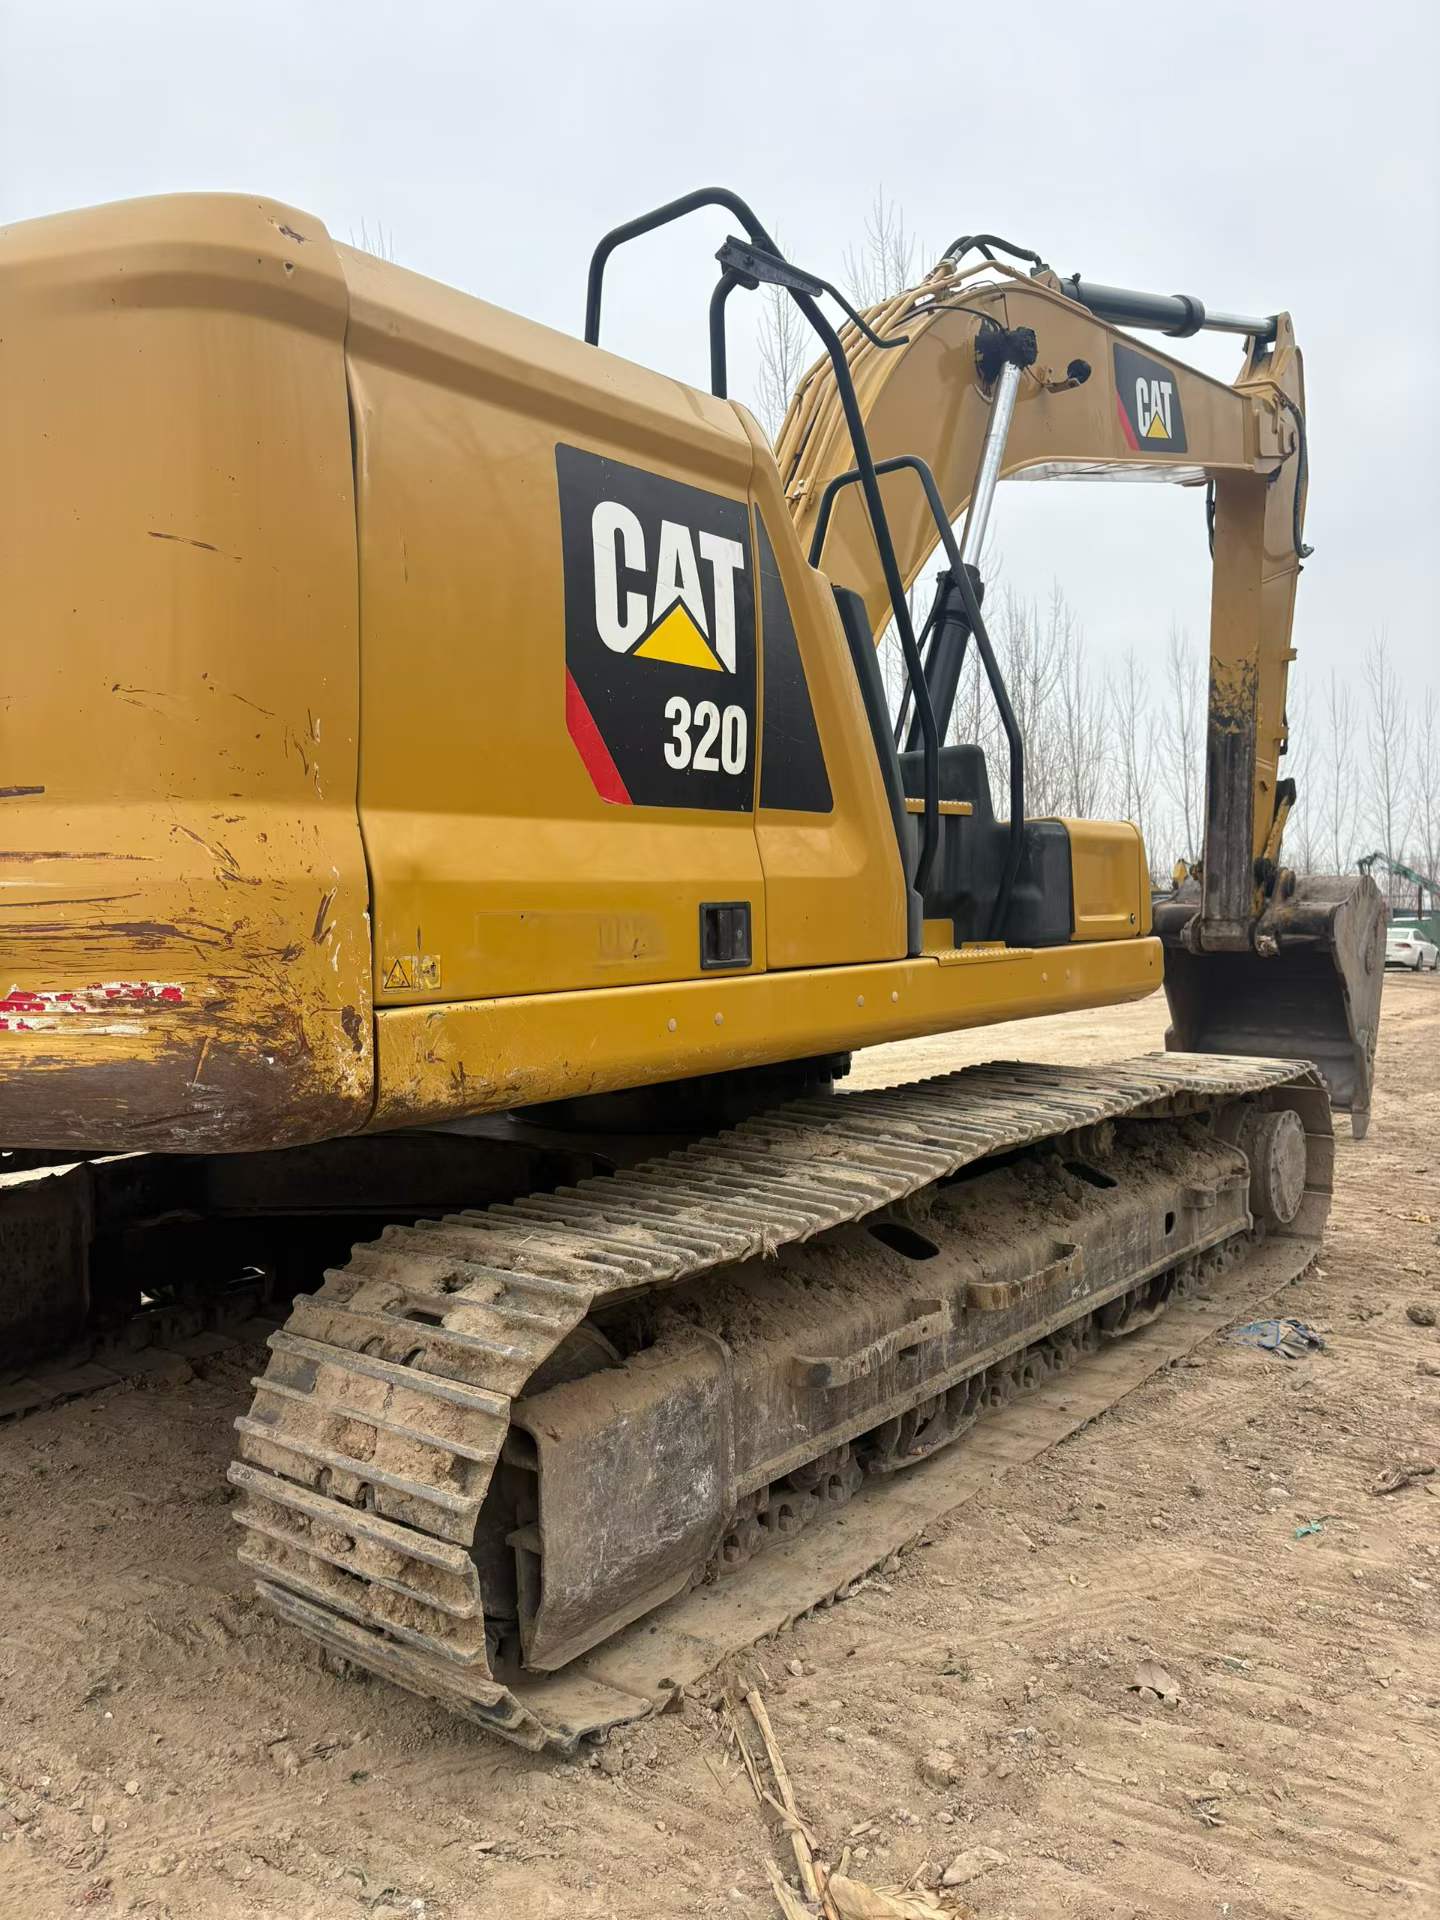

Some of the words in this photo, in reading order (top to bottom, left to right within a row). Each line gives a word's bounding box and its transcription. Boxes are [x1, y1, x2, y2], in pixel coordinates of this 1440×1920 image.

[1136, 377, 1172, 439] CAT
[592, 501, 744, 674] CAT
[664, 696, 748, 776] 320
